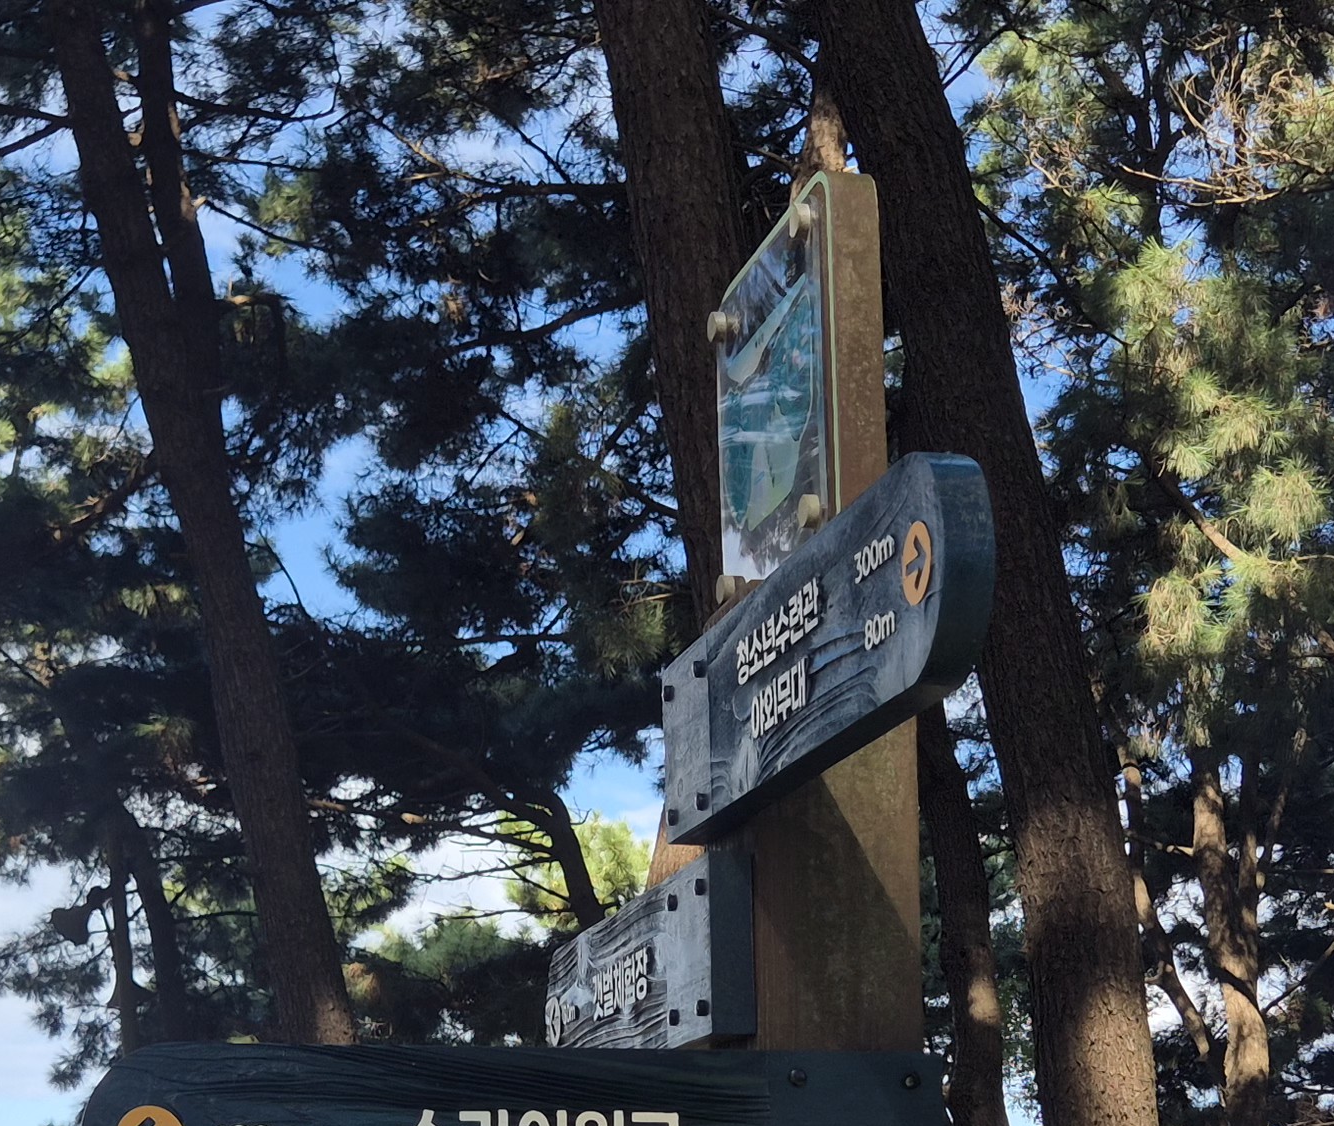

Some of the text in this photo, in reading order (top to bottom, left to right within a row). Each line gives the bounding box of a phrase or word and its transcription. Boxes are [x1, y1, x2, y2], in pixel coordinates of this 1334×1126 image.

[735, 577, 820, 686] 청소년수련관
[853, 534, 896, 584] 300m
[751, 611, 897, 739] 야외무대 80m
[592, 947, 648, 1021] 갯벌체험장
